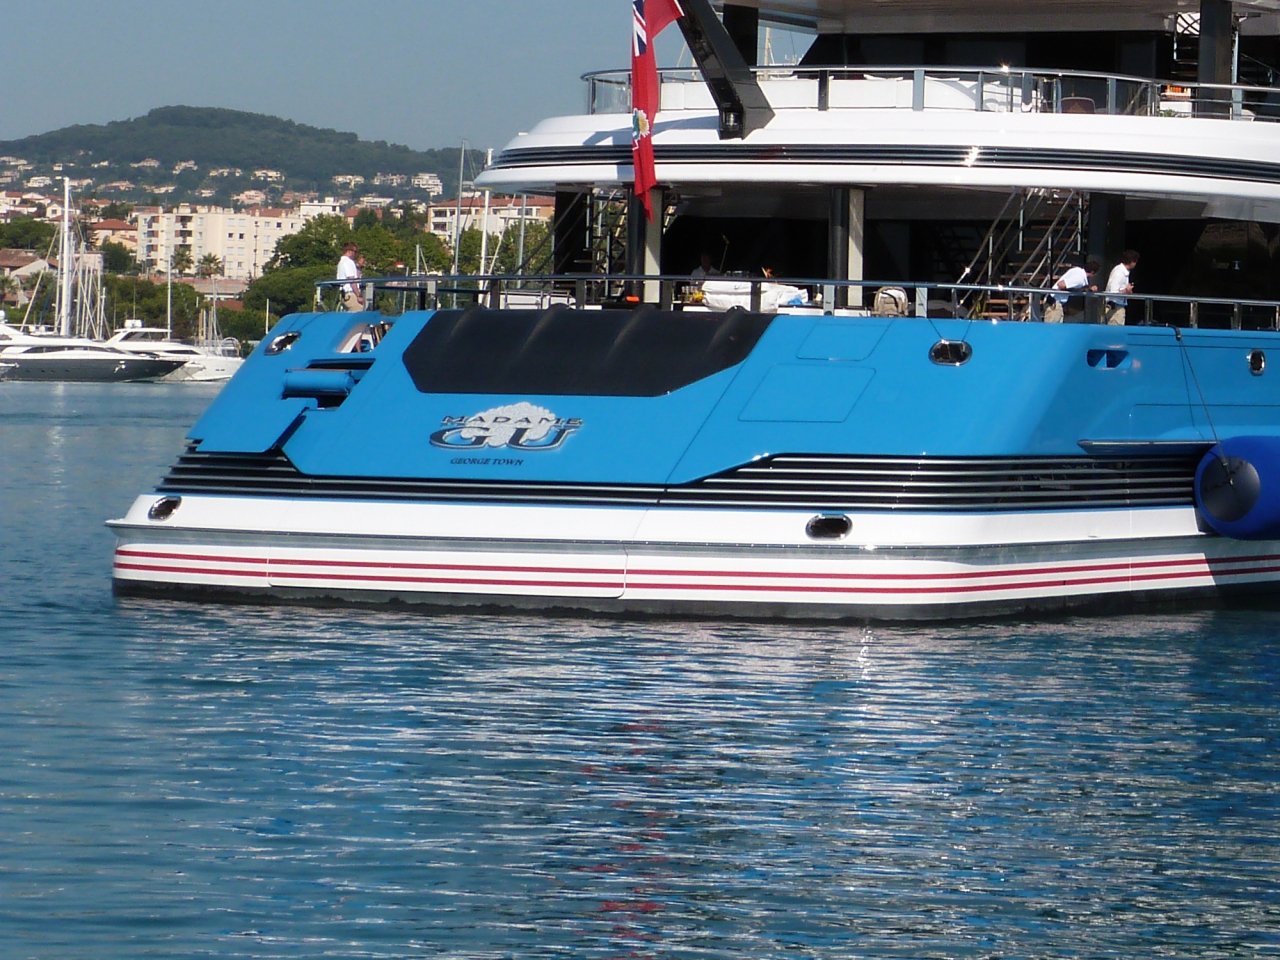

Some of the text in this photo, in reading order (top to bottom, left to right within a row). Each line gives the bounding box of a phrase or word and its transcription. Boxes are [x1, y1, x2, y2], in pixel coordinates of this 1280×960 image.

[441, 415, 583, 428] MADAME
[429, 425, 576, 451] GU
[450, 457, 524, 466] GEORGE TOWN
